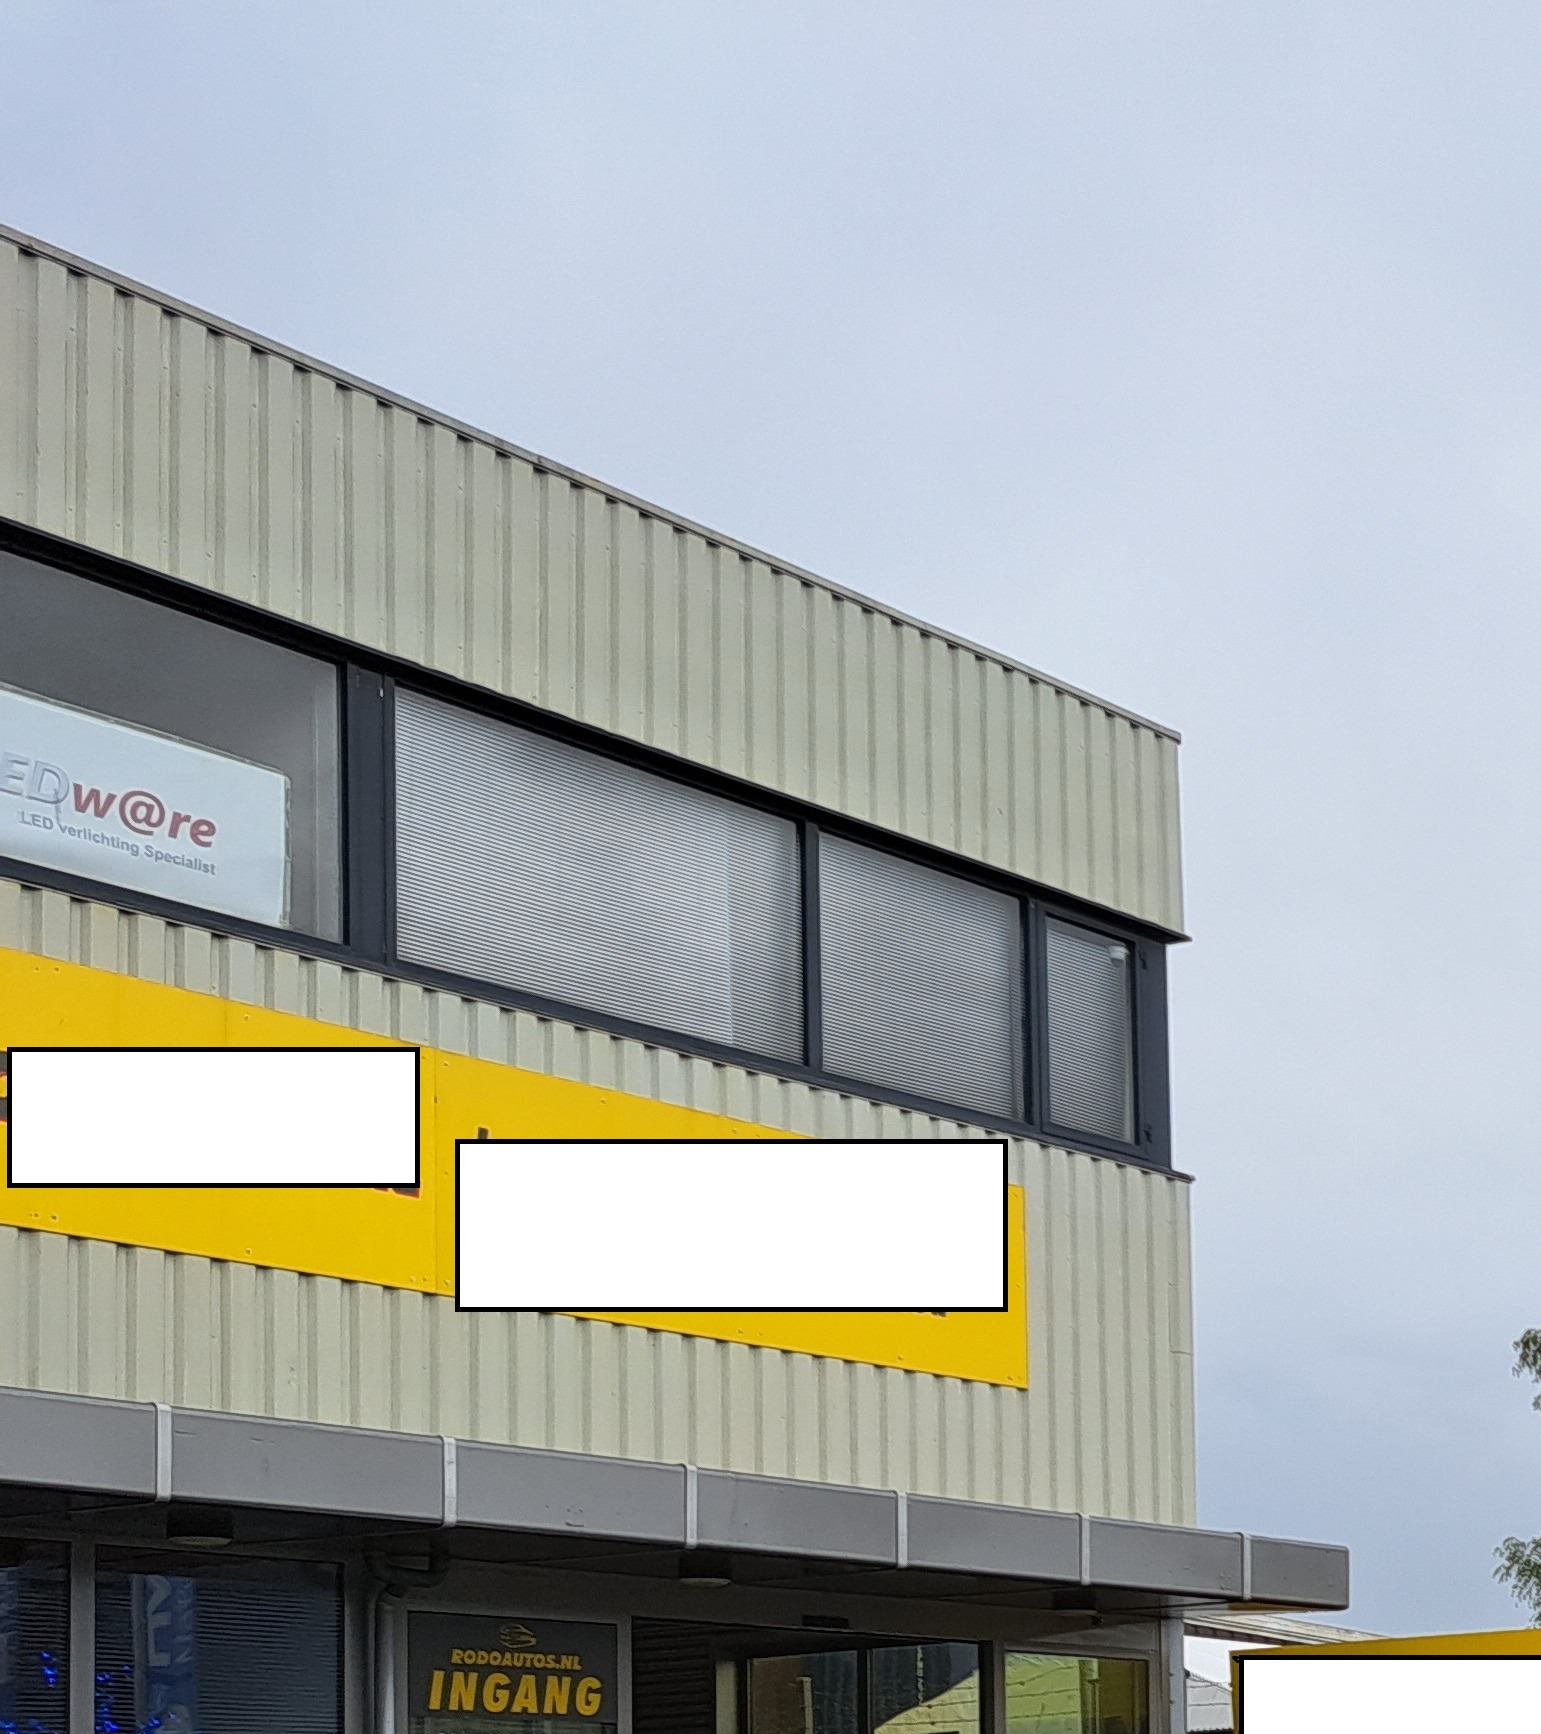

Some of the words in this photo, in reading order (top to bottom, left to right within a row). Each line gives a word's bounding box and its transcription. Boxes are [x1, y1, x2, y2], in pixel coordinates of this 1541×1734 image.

[19, 810, 54, 831] LED
[59, 823, 140, 857] verlichting
[144, 844, 217, 876] Specialist
[451, 1649, 582, 1670] RODOAUTOS.NL
[428, 1669, 602, 1716] INGANG
